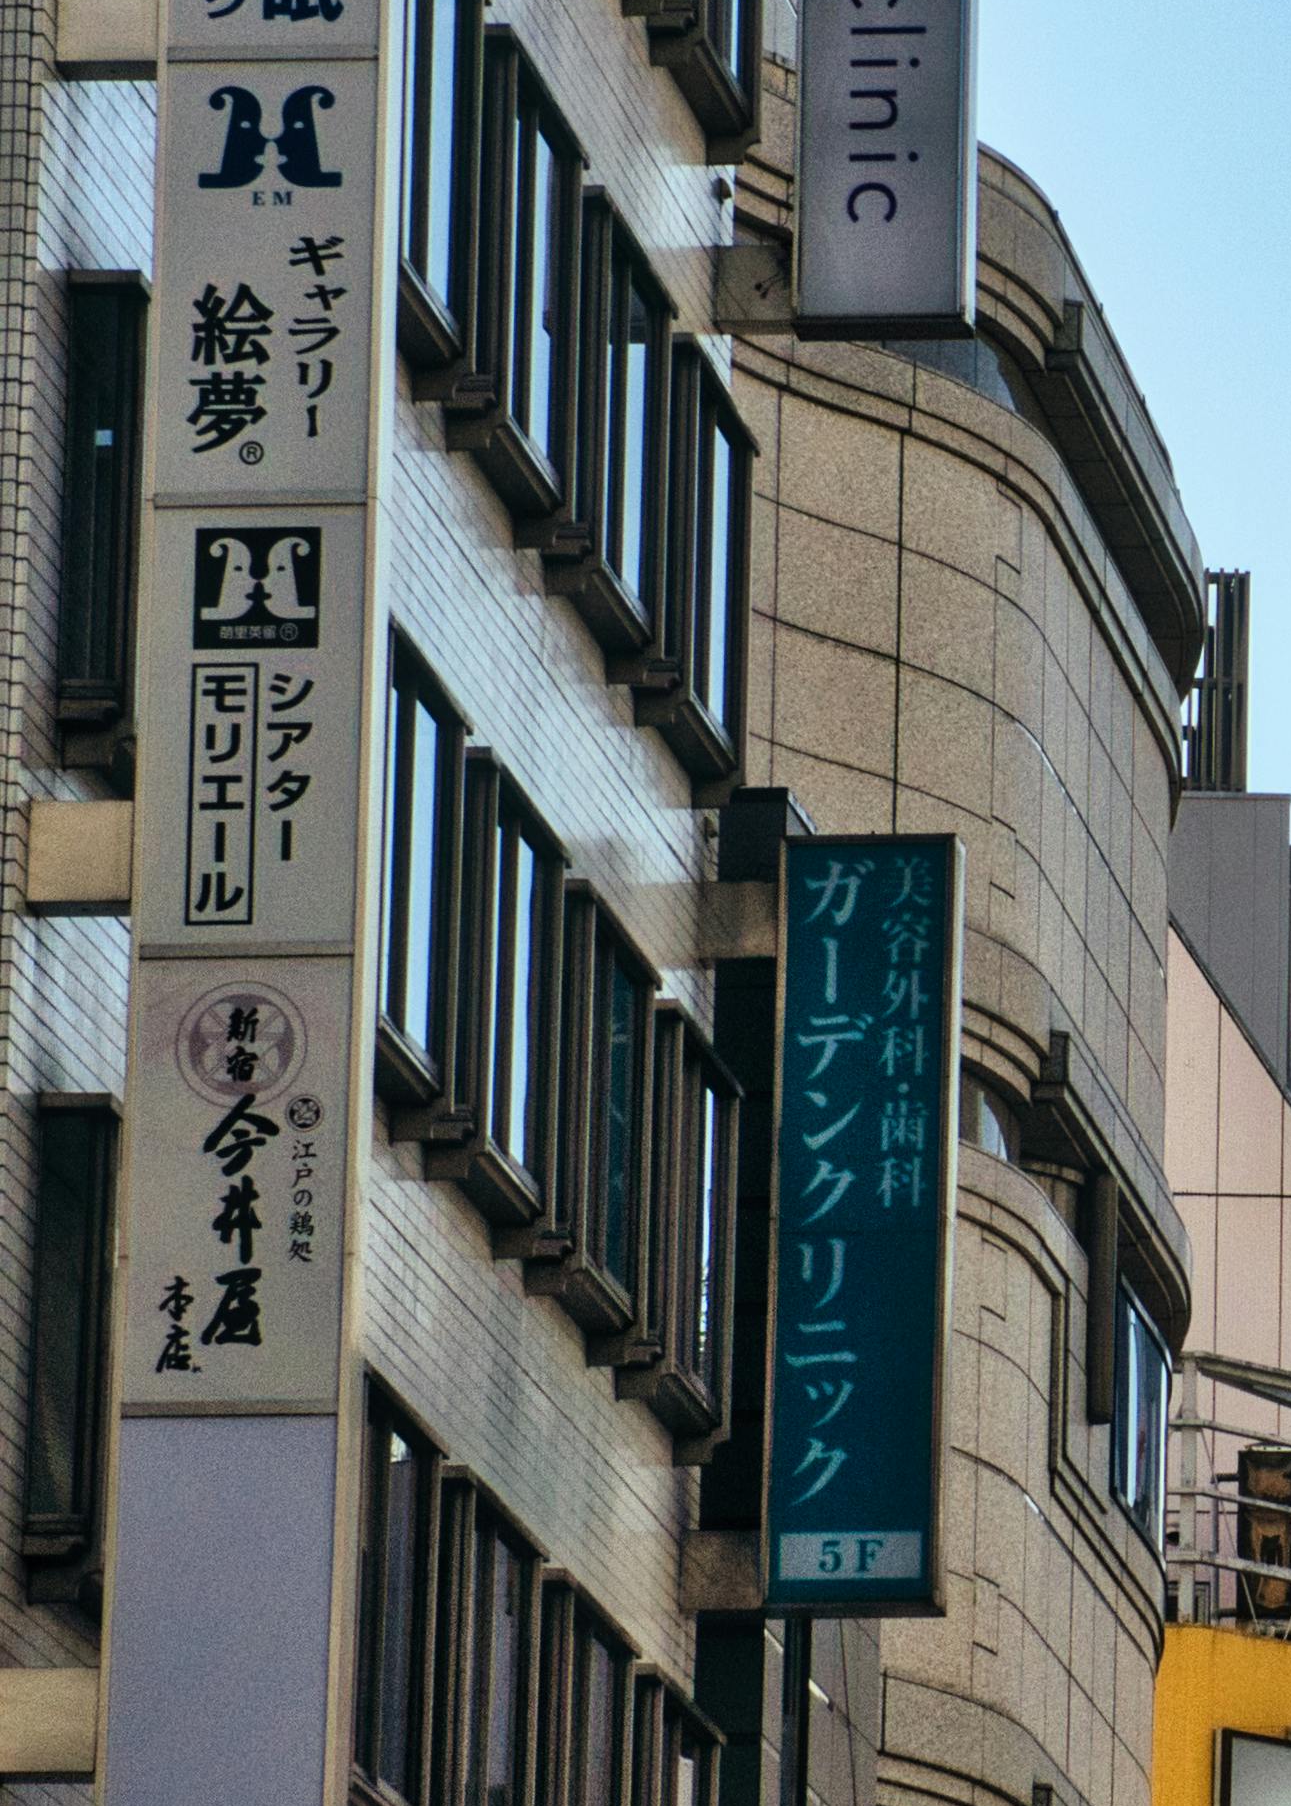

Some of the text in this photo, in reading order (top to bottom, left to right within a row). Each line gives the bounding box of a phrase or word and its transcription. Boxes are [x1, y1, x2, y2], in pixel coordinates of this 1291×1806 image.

[288, 234, 347, 438] ギャラリー
[195, 674, 252, 916] モリエール
[267, 672, 315, 862] シアター
[880, 857, 931, 1209] 美容外科・歯科
[202, 1095, 280, 1347] 今井屋
[785, 857, 875, 1508] ガーデンクリニック
[818, 1540, 885, 1574] 5F
